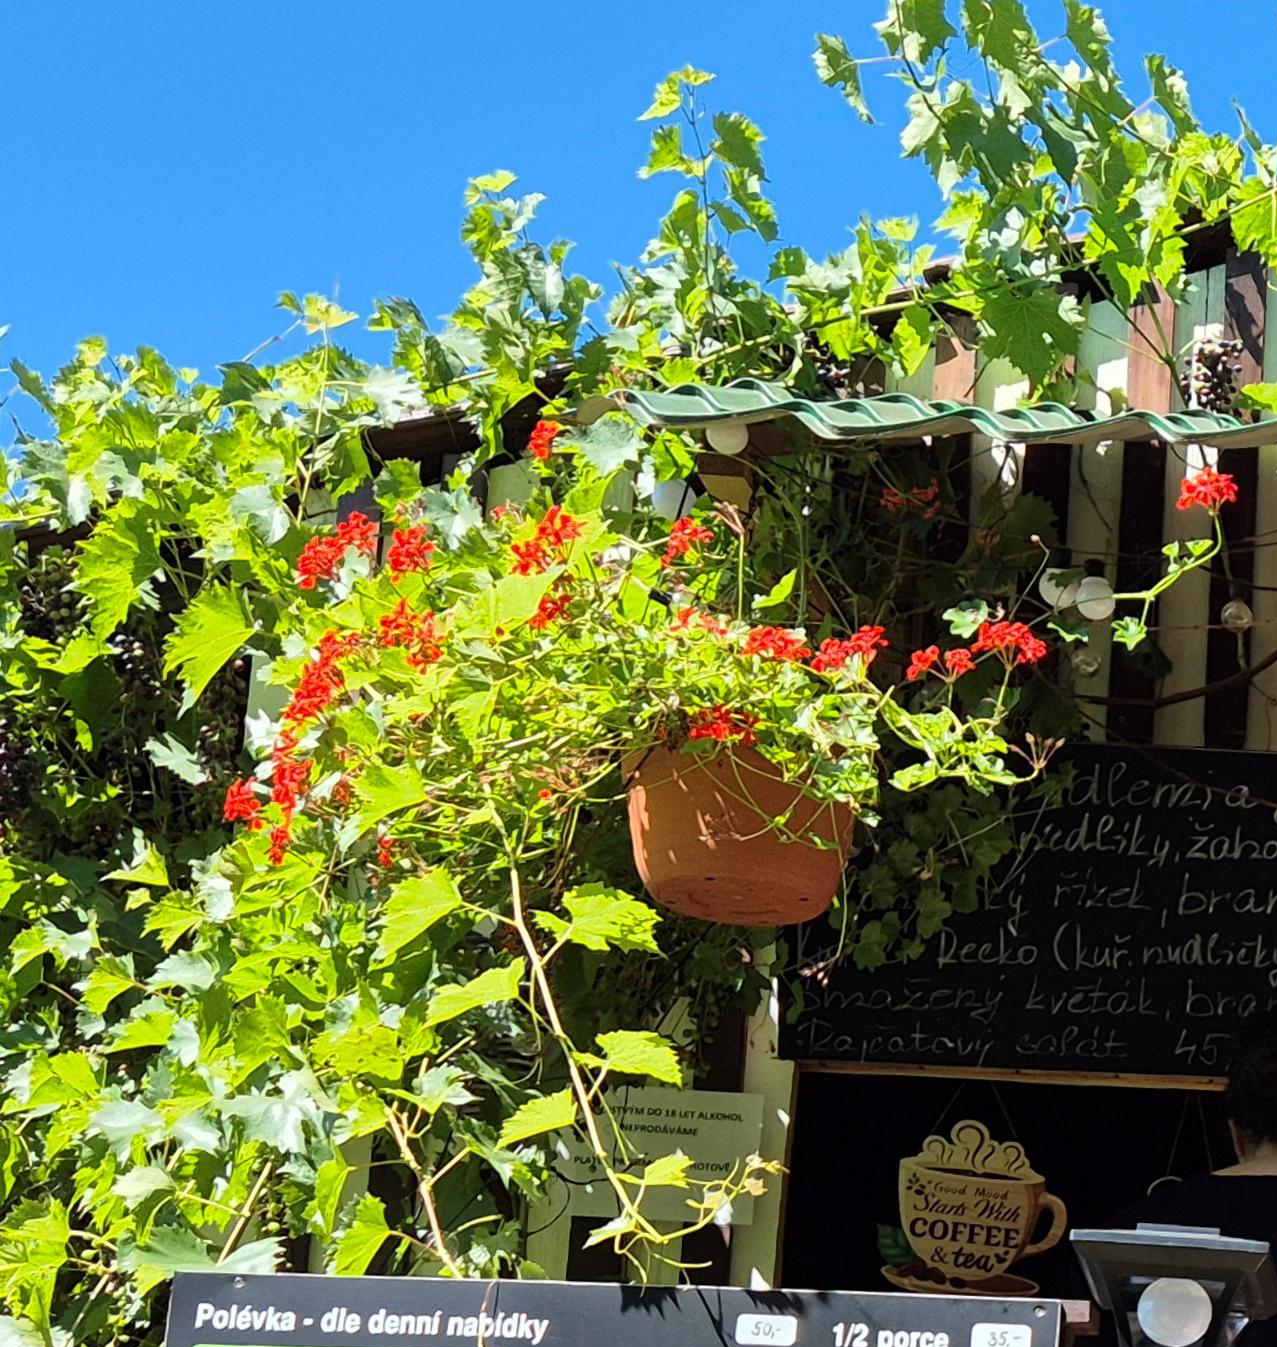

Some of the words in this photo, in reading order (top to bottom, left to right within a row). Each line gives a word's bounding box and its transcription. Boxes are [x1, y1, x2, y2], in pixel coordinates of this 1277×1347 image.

[909, 1217, 1020, 1249] COFFEE
[952, 1247, 995, 1273] tea
[195, 1303, 296, 1331] Polévka
[321, 1307, 360, 1333] dle
[368, 1309, 442, 1335] denní
[833, 1323, 869, 1347] 1/2
